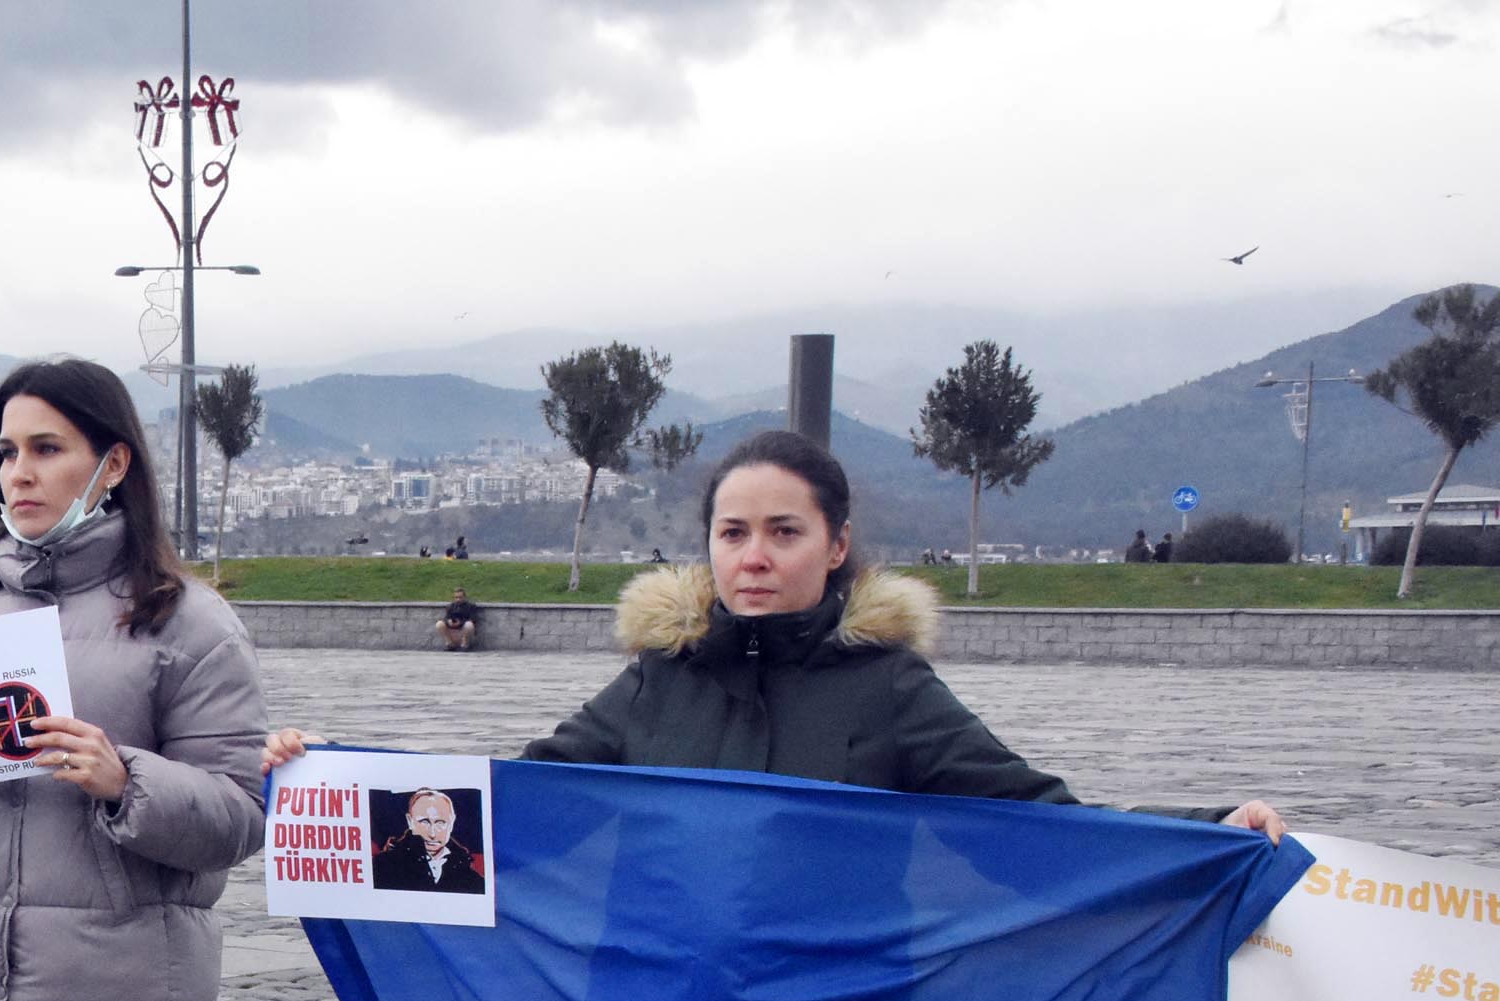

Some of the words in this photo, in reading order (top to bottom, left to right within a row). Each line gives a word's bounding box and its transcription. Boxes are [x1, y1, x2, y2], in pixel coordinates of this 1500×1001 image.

[2, 667, 37, 680] RUSSIA
[275, 782, 360, 818] PUTİN'İ
[274, 823, 362, 851] DURDUR
[274, 850, 364, 884] TÜRKİYE
